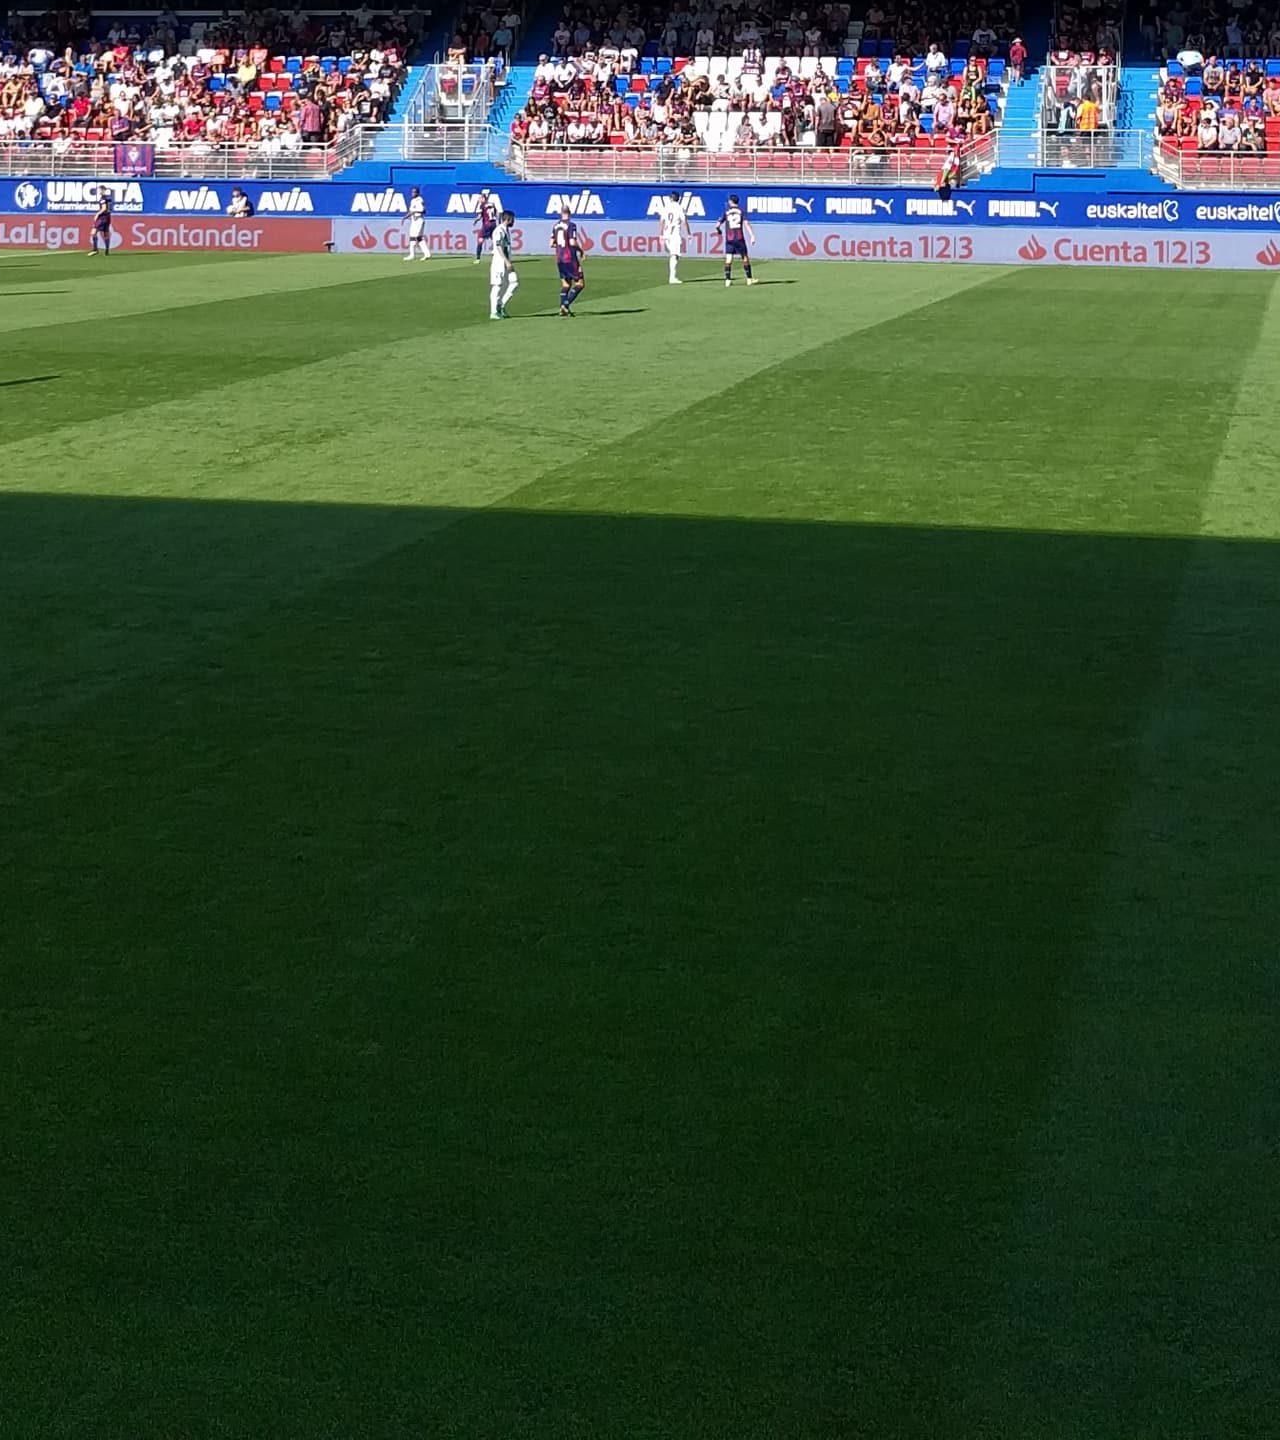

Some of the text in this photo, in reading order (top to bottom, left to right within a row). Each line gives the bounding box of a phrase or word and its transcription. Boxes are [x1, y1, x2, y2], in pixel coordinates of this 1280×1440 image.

[1087, 201, 1163, 220] euskaltel
[1196, 203, 1273, 222] euskaltel
[131, 223, 263, 249] Santander
[823, 235, 912, 258] Cuenta
[1054, 238, 1148, 263] Cuenta
